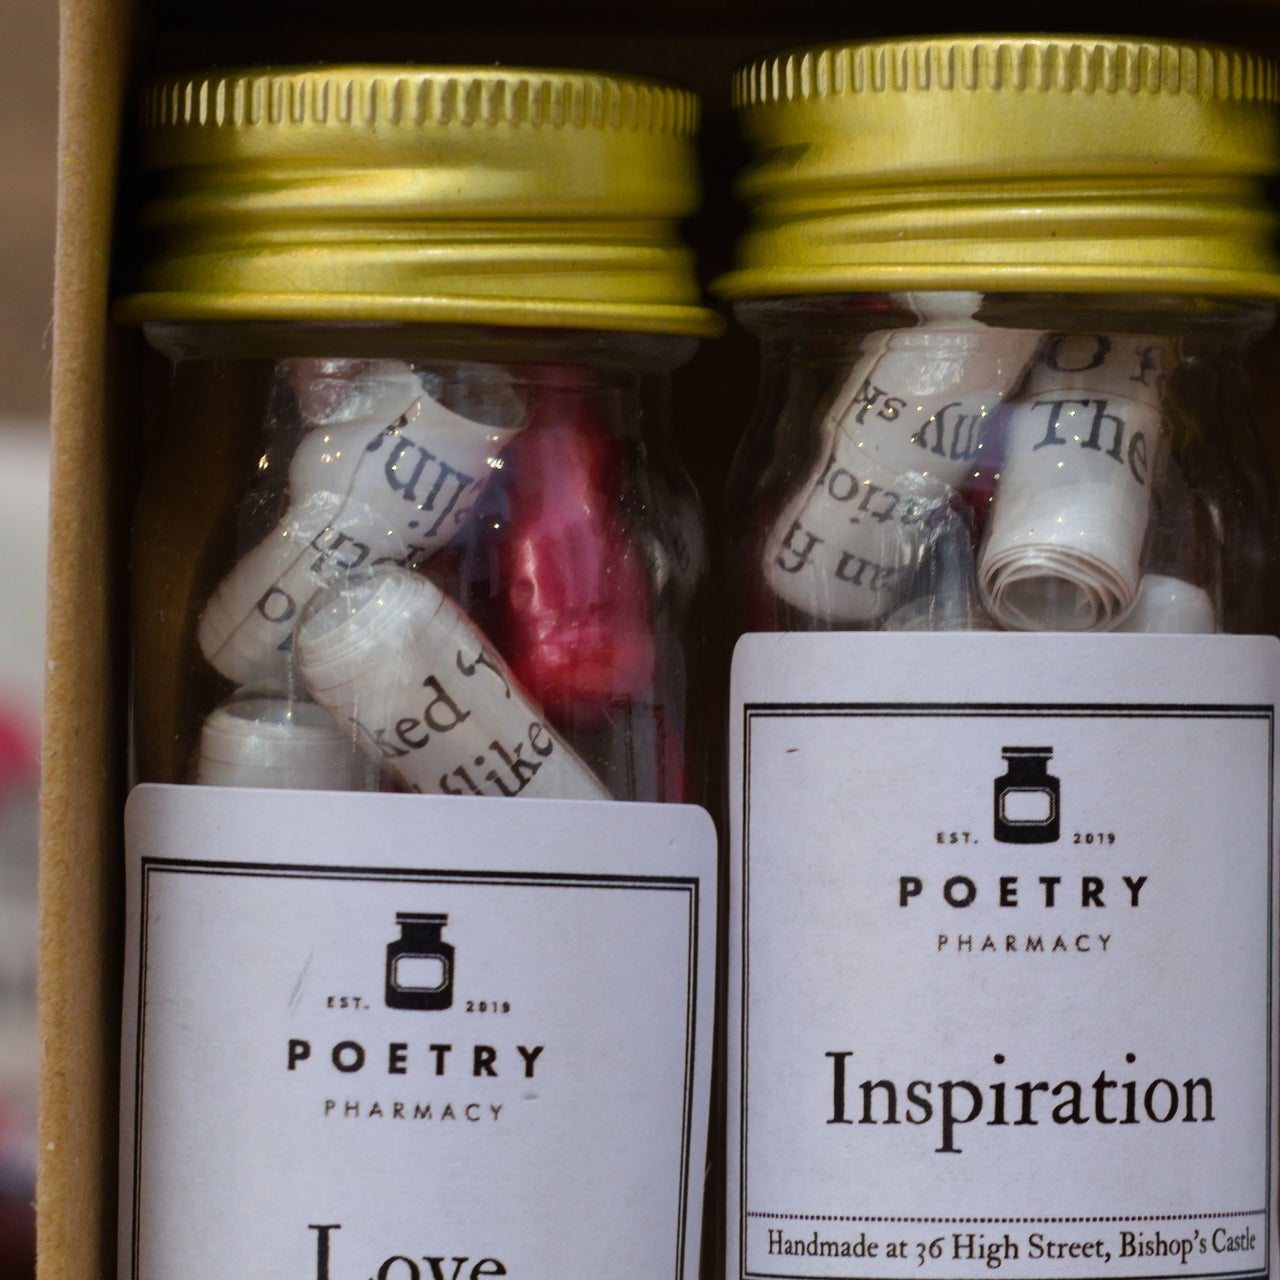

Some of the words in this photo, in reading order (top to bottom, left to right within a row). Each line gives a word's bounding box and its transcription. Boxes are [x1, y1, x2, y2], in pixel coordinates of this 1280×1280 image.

[1031, 399, 1148, 486] The
[936, 831, 978, 845] EST.
[1073, 832, 1116, 845] 2019
[899, 875, 1148, 909] POETRY
[938, 933, 1111, 953] PHARMACY
[326, 995, 370, 1010] EST.
[465, 1000, 511, 1014] 2019
[287, 1038, 544, 1079] POETRY
[324, 1099, 503, 1123] PHARMACY
[824, 1051, 1216, 1154] Inspiration
[767, 1228, 879, 1258] Handmade
[885, 1240, 909, 1259] at
[916, 1236, 946, 1267] 36
[952, 1233, 1019, 1269] High
[1028, 1233, 1112, 1264] Street,
[1119, 1229, 1207, 1265] Bishop's
[1211, 1226, 1257, 1254] Castle
